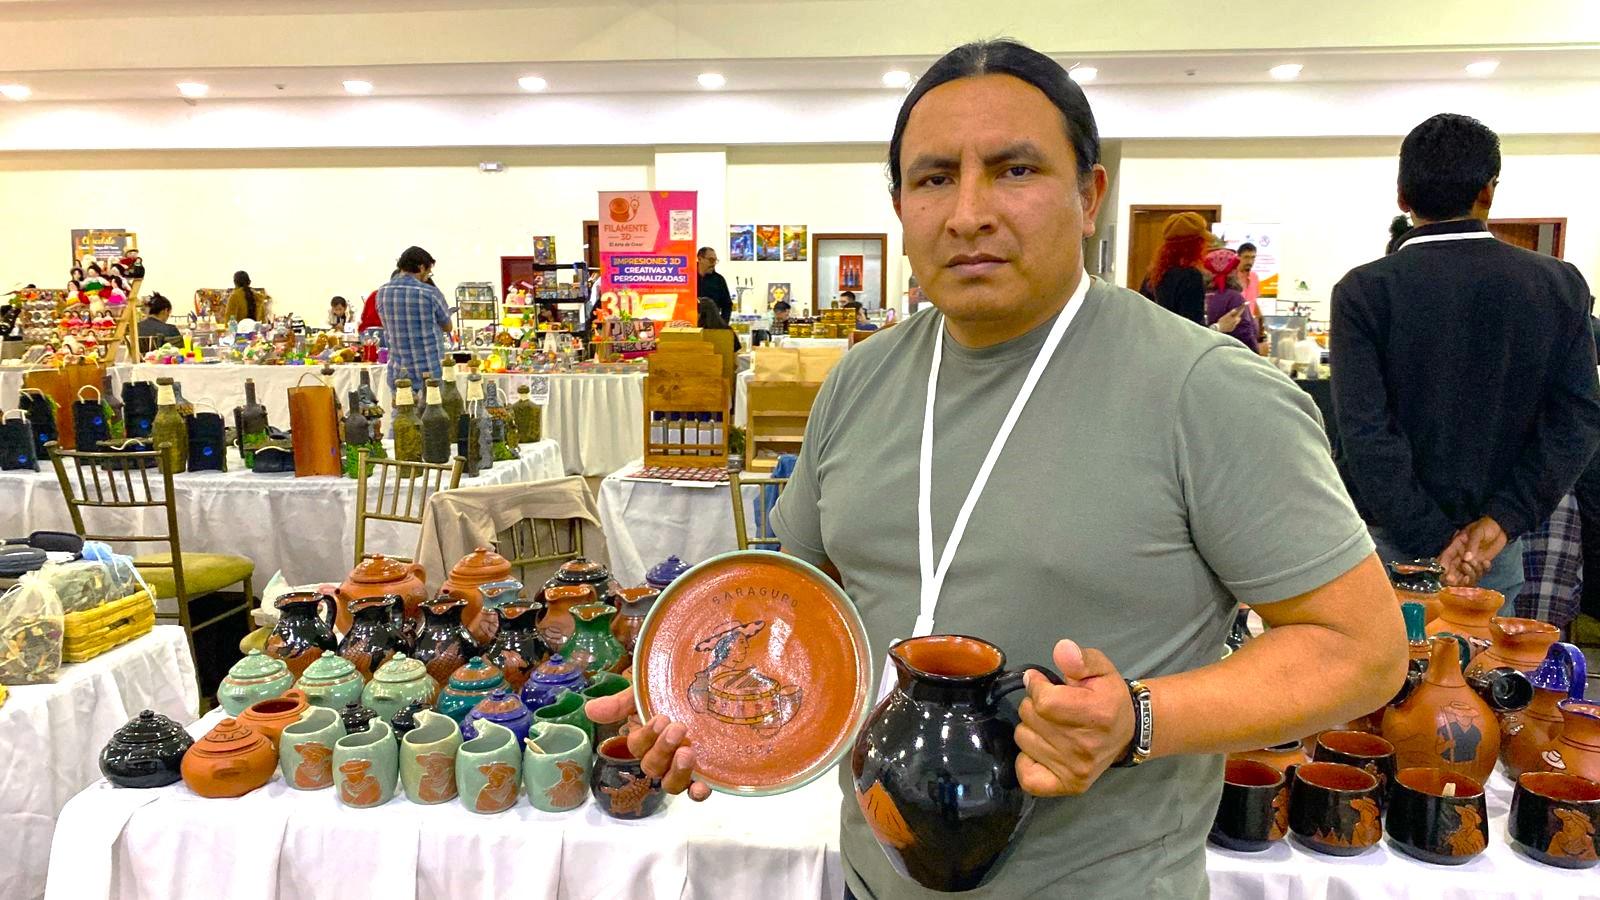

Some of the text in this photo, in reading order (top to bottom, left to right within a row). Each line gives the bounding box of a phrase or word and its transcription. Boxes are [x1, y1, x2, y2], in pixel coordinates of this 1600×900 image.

[604, 224, 648, 233] FILAMENTE
[620, 233, 632, 241] 3D
[669, 257, 681, 265] 3D
[624, 266, 674, 274] CREATIVAS Y
[712, 586, 799, 608] SARAGURO
